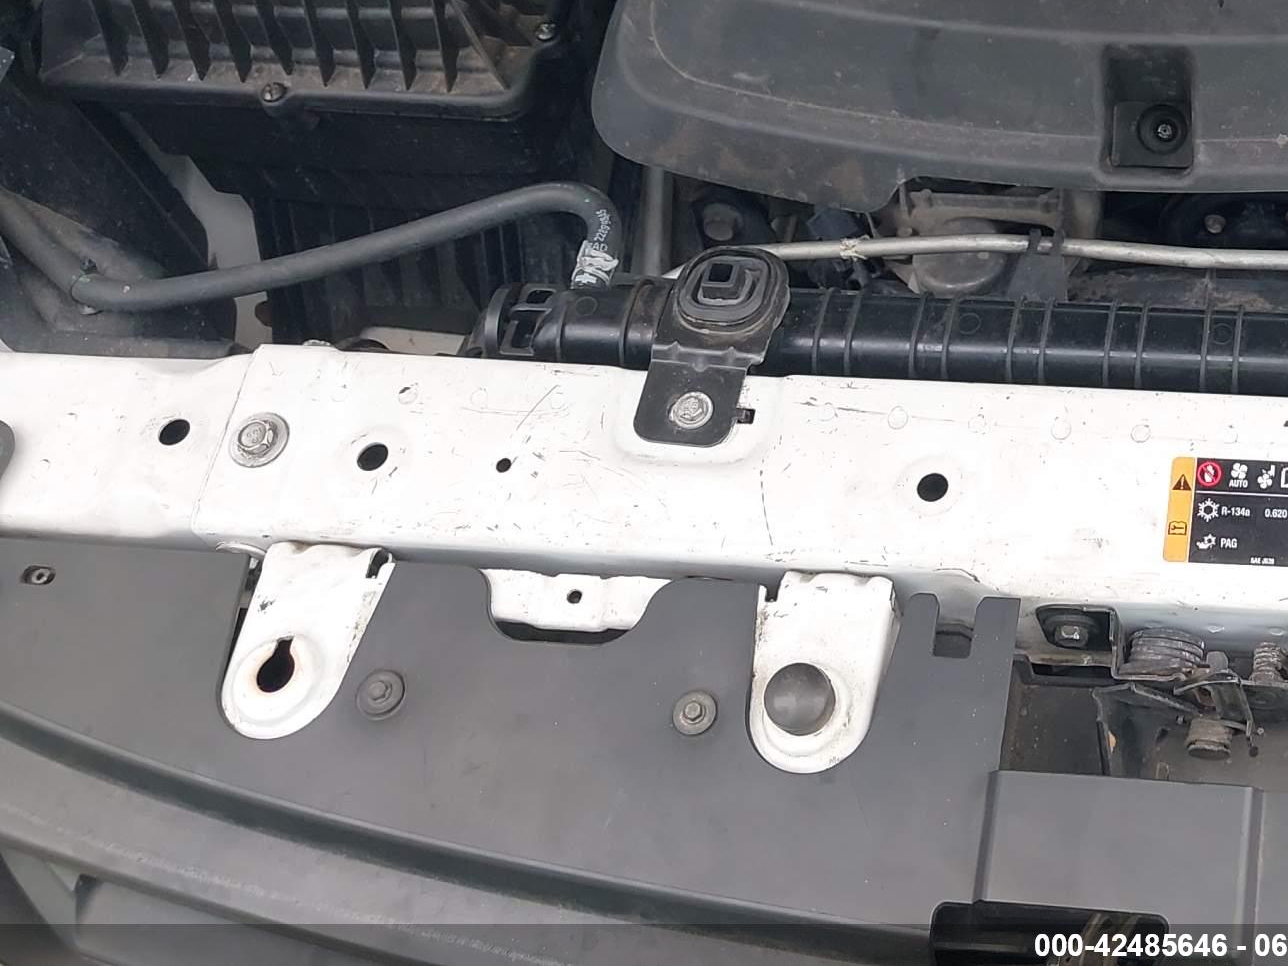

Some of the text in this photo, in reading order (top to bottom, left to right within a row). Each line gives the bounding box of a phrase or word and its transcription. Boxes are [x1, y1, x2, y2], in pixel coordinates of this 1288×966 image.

[1228, 479, 1249, 488] AUTO
[1221, 505, 1251, 517] R-134a
[1264, 508, 1288, 519] 0.620
[1220, 538, 1238, 549] PAG
